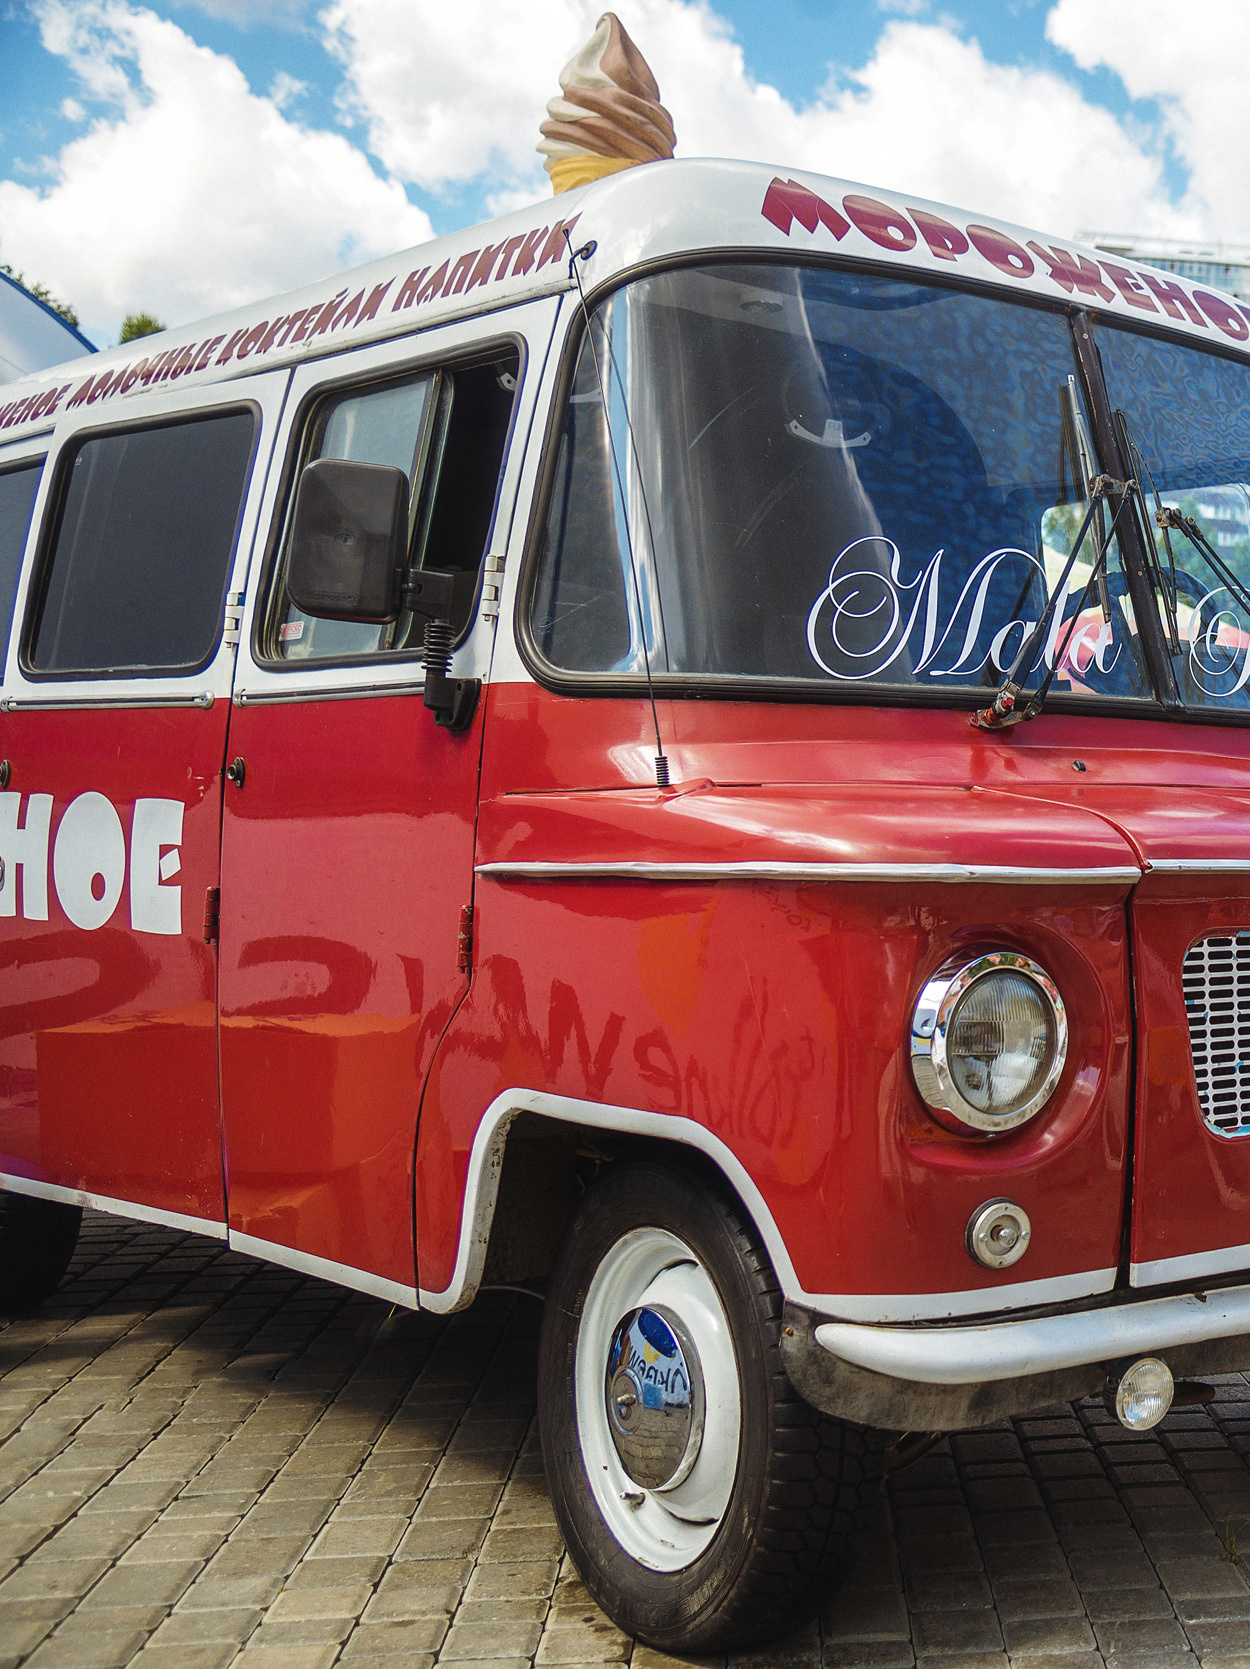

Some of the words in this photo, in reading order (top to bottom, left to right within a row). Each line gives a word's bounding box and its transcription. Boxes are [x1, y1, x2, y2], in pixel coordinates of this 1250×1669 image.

[65, 334, 227, 412] МОЛОЧНЫЕ
[215, 274, 398, 366] КОКТЕЙЛИ
[391, 211, 584, 313] НАПИТКИ
[806, 536, 1123, 681] Mala
[0, 791, 185, 935] НОЕ
